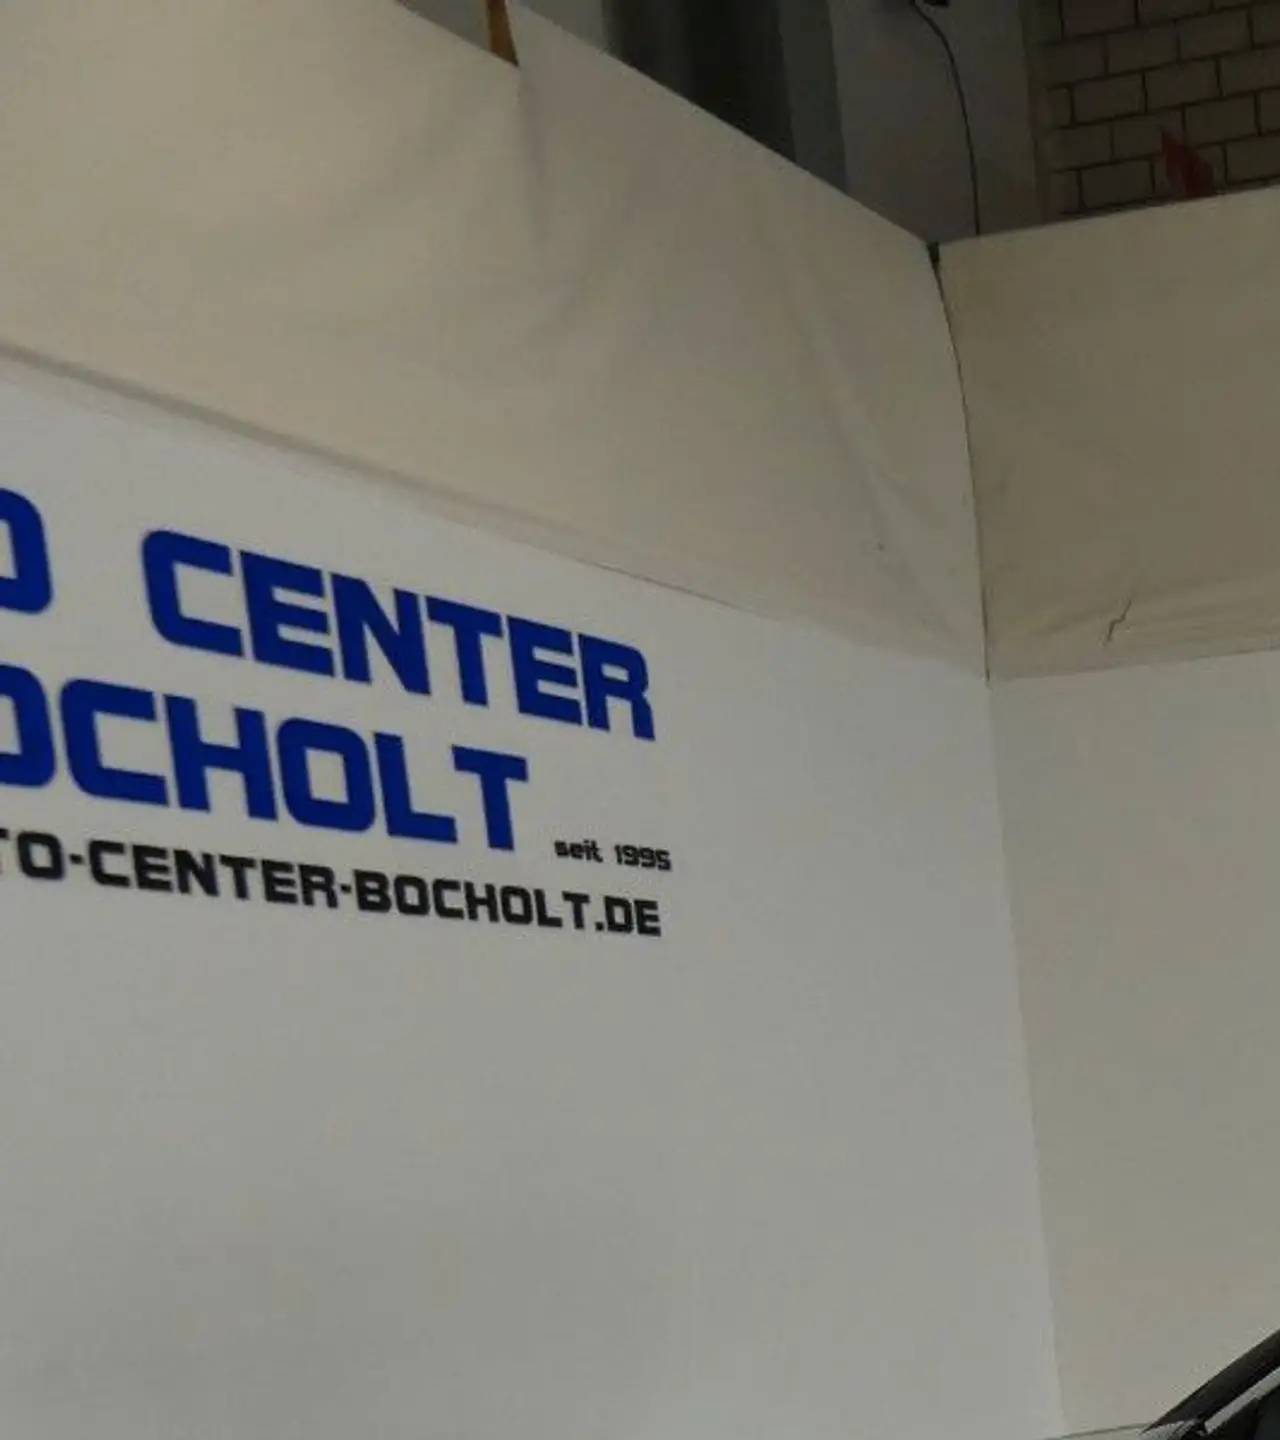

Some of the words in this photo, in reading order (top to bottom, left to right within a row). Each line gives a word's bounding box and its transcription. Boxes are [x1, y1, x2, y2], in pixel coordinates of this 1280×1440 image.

[142, 530, 655, 741] CENTER
[554, 839, 603, 863] seit
[614, 844, 672, 871] 1995
